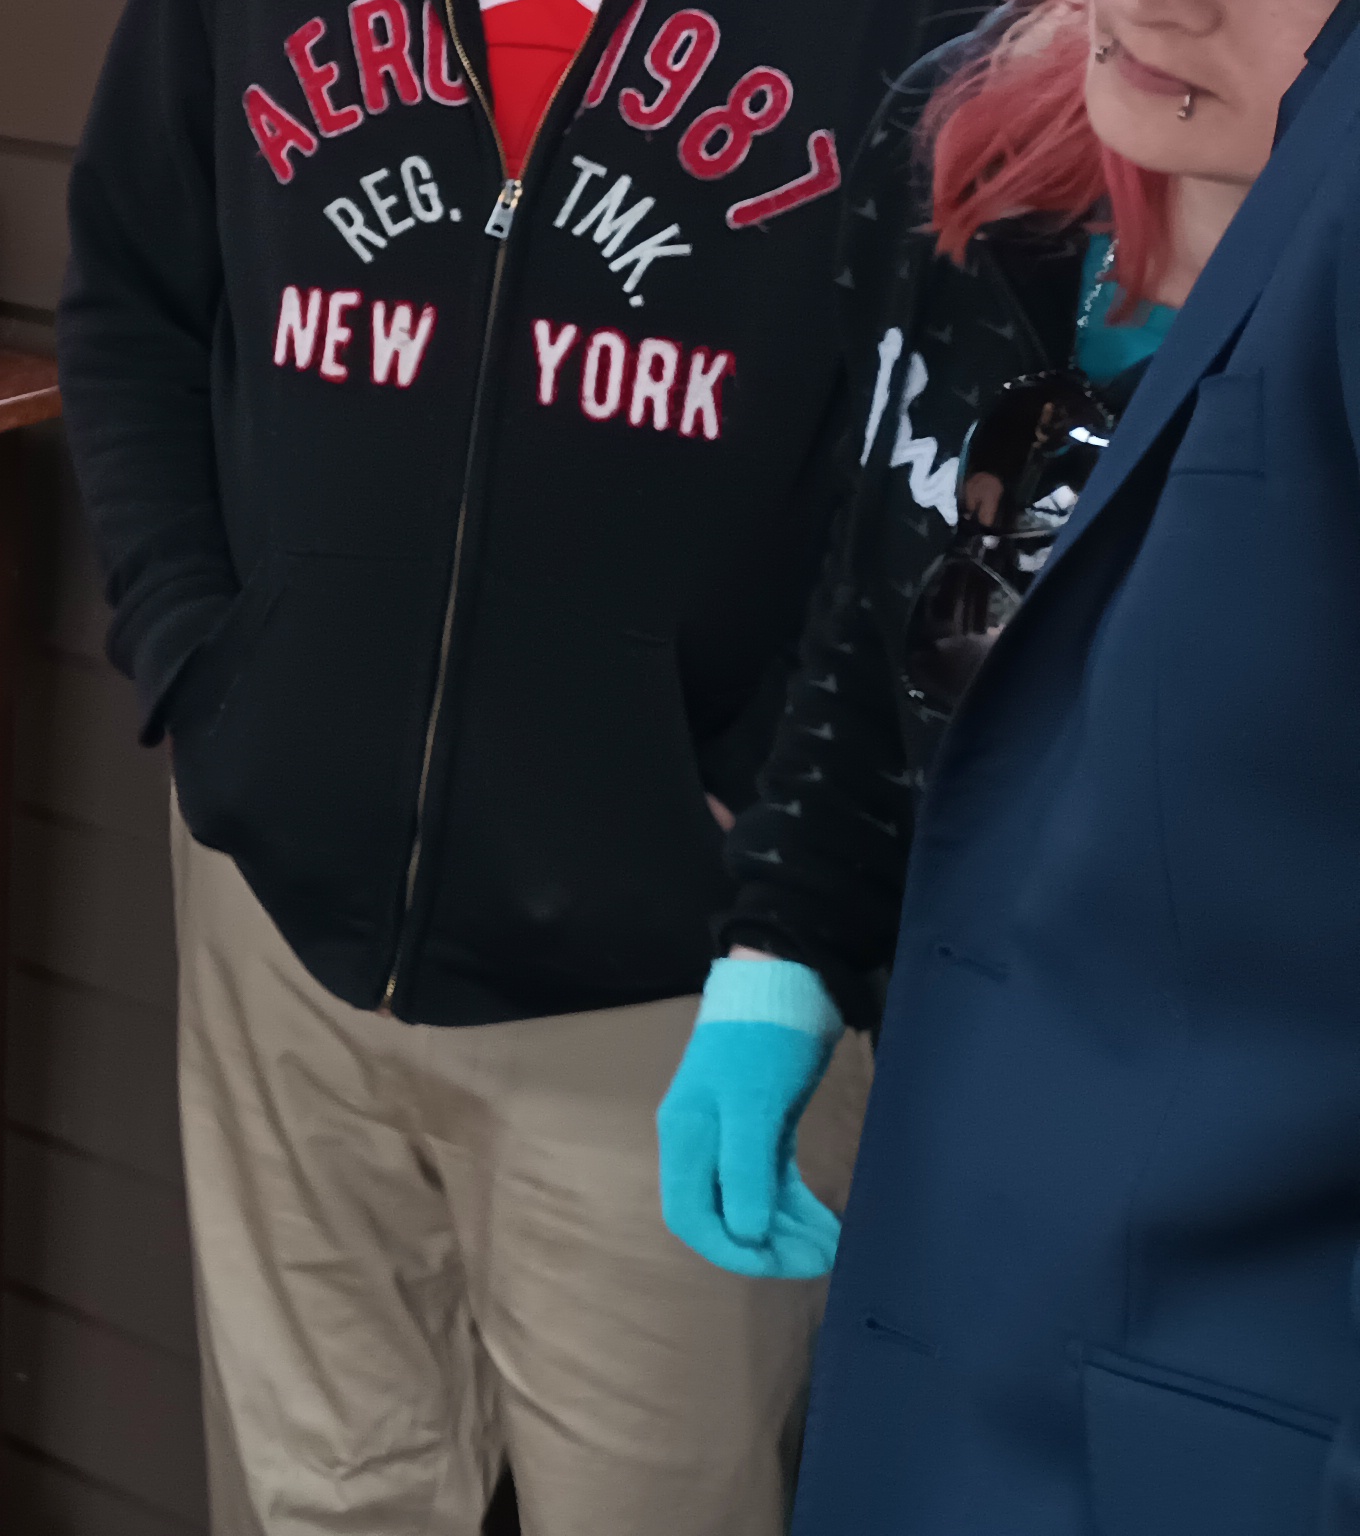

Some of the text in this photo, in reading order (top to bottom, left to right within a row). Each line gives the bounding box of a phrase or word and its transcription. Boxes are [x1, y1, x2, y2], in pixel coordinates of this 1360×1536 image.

[323, 155, 691, 307] REG. TMK.
[273, 286, 437, 388] NEW
[532, 318, 736, 440] YORK
